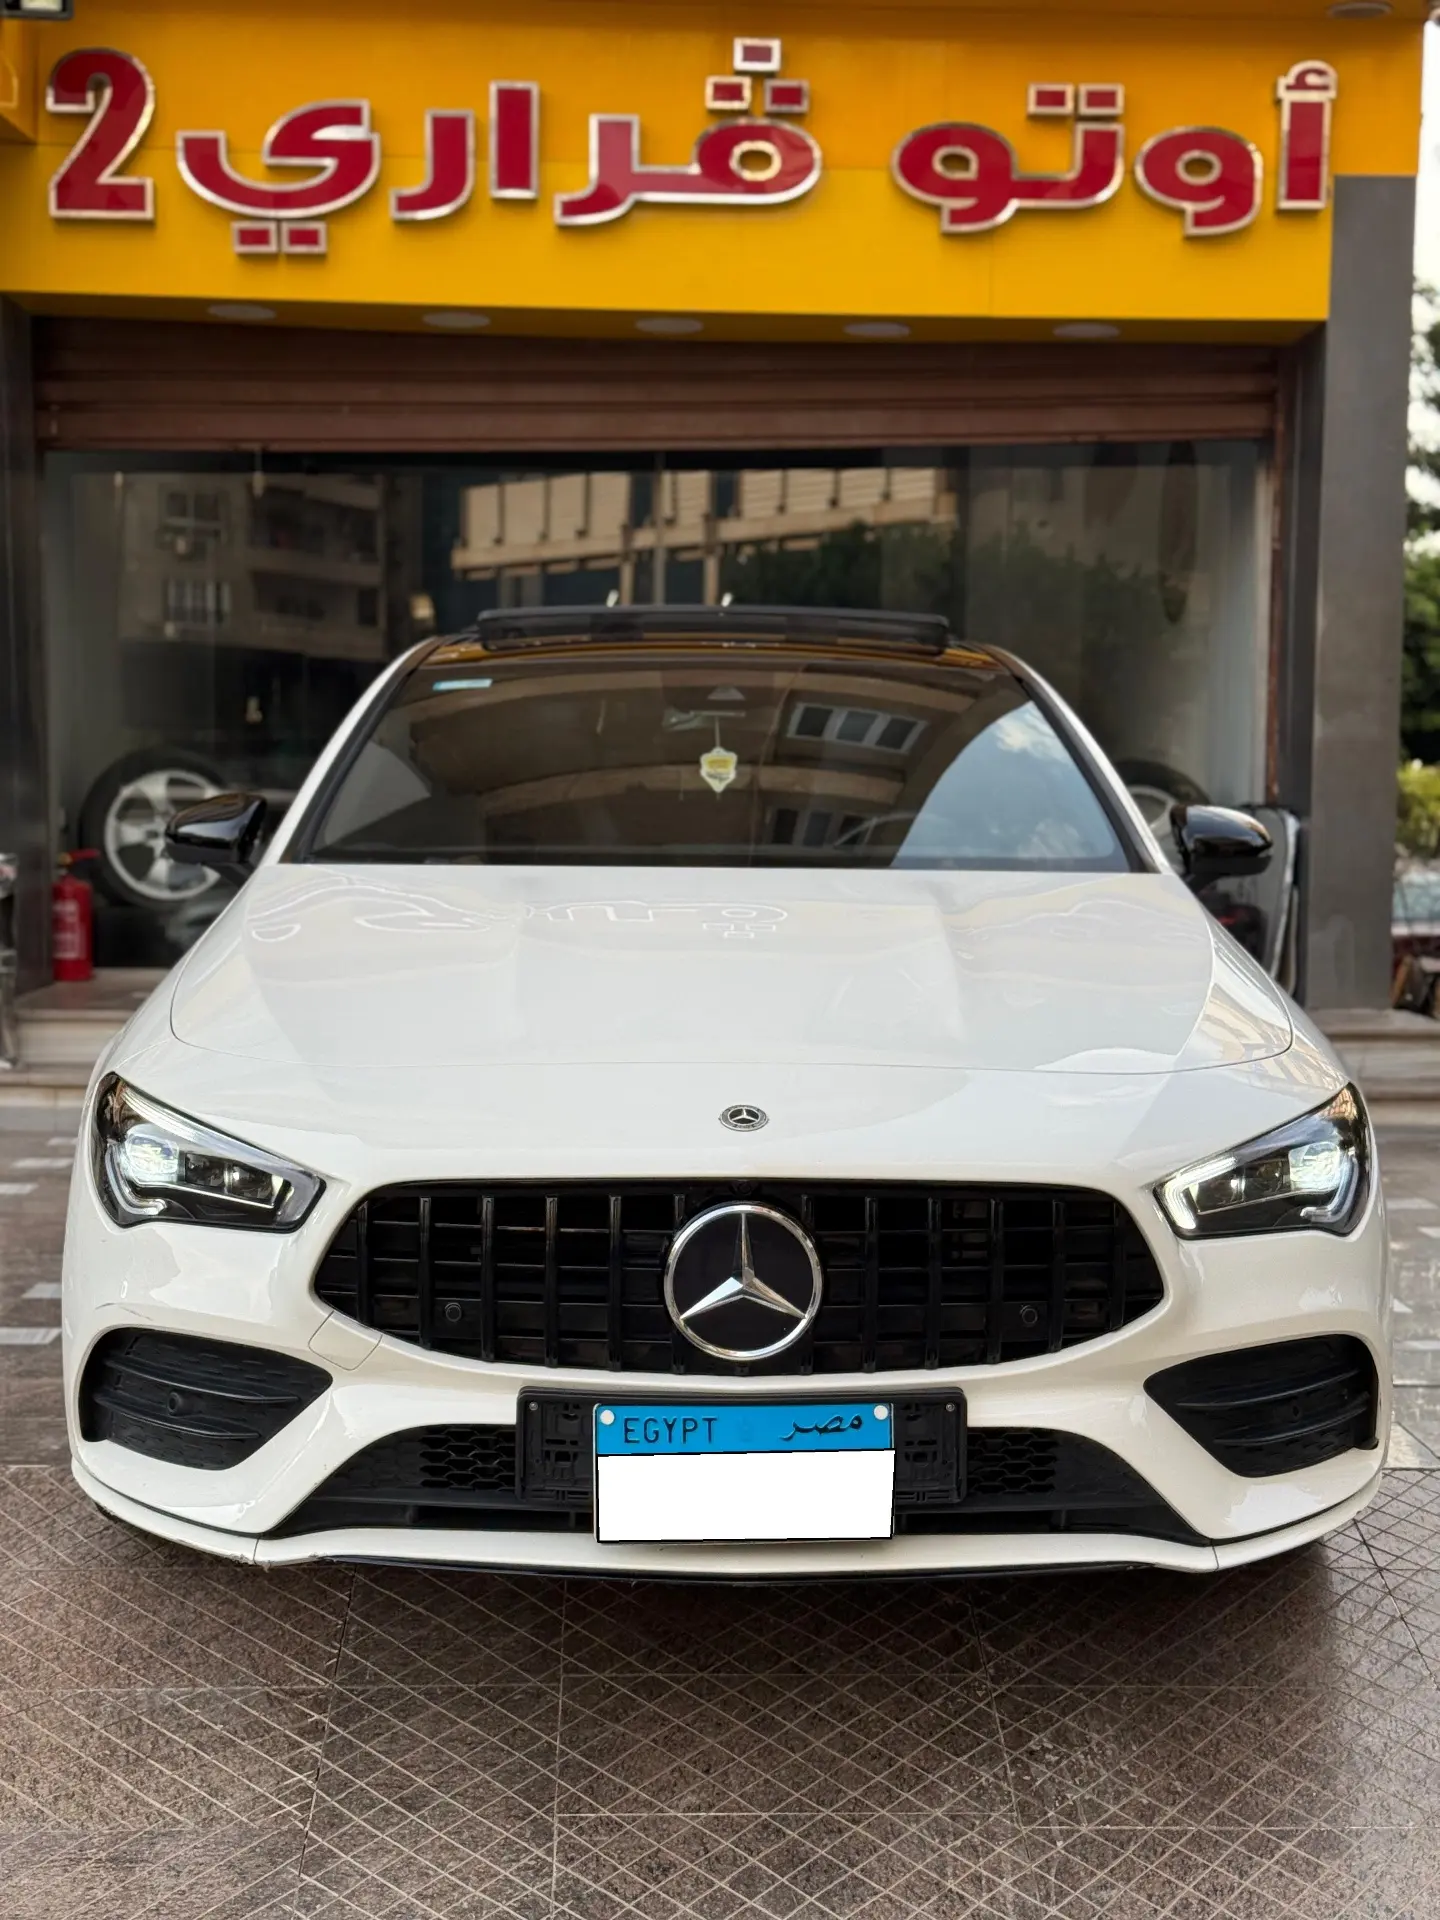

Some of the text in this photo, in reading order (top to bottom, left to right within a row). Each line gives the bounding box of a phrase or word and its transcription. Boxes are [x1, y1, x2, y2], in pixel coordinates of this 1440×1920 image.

[45, 47, 155, 220] 2
[890, 60, 1338, 237] أوتو
[623, 1416, 718, 1444] EGYPT
[780, 1411, 864, 1442] مصر
